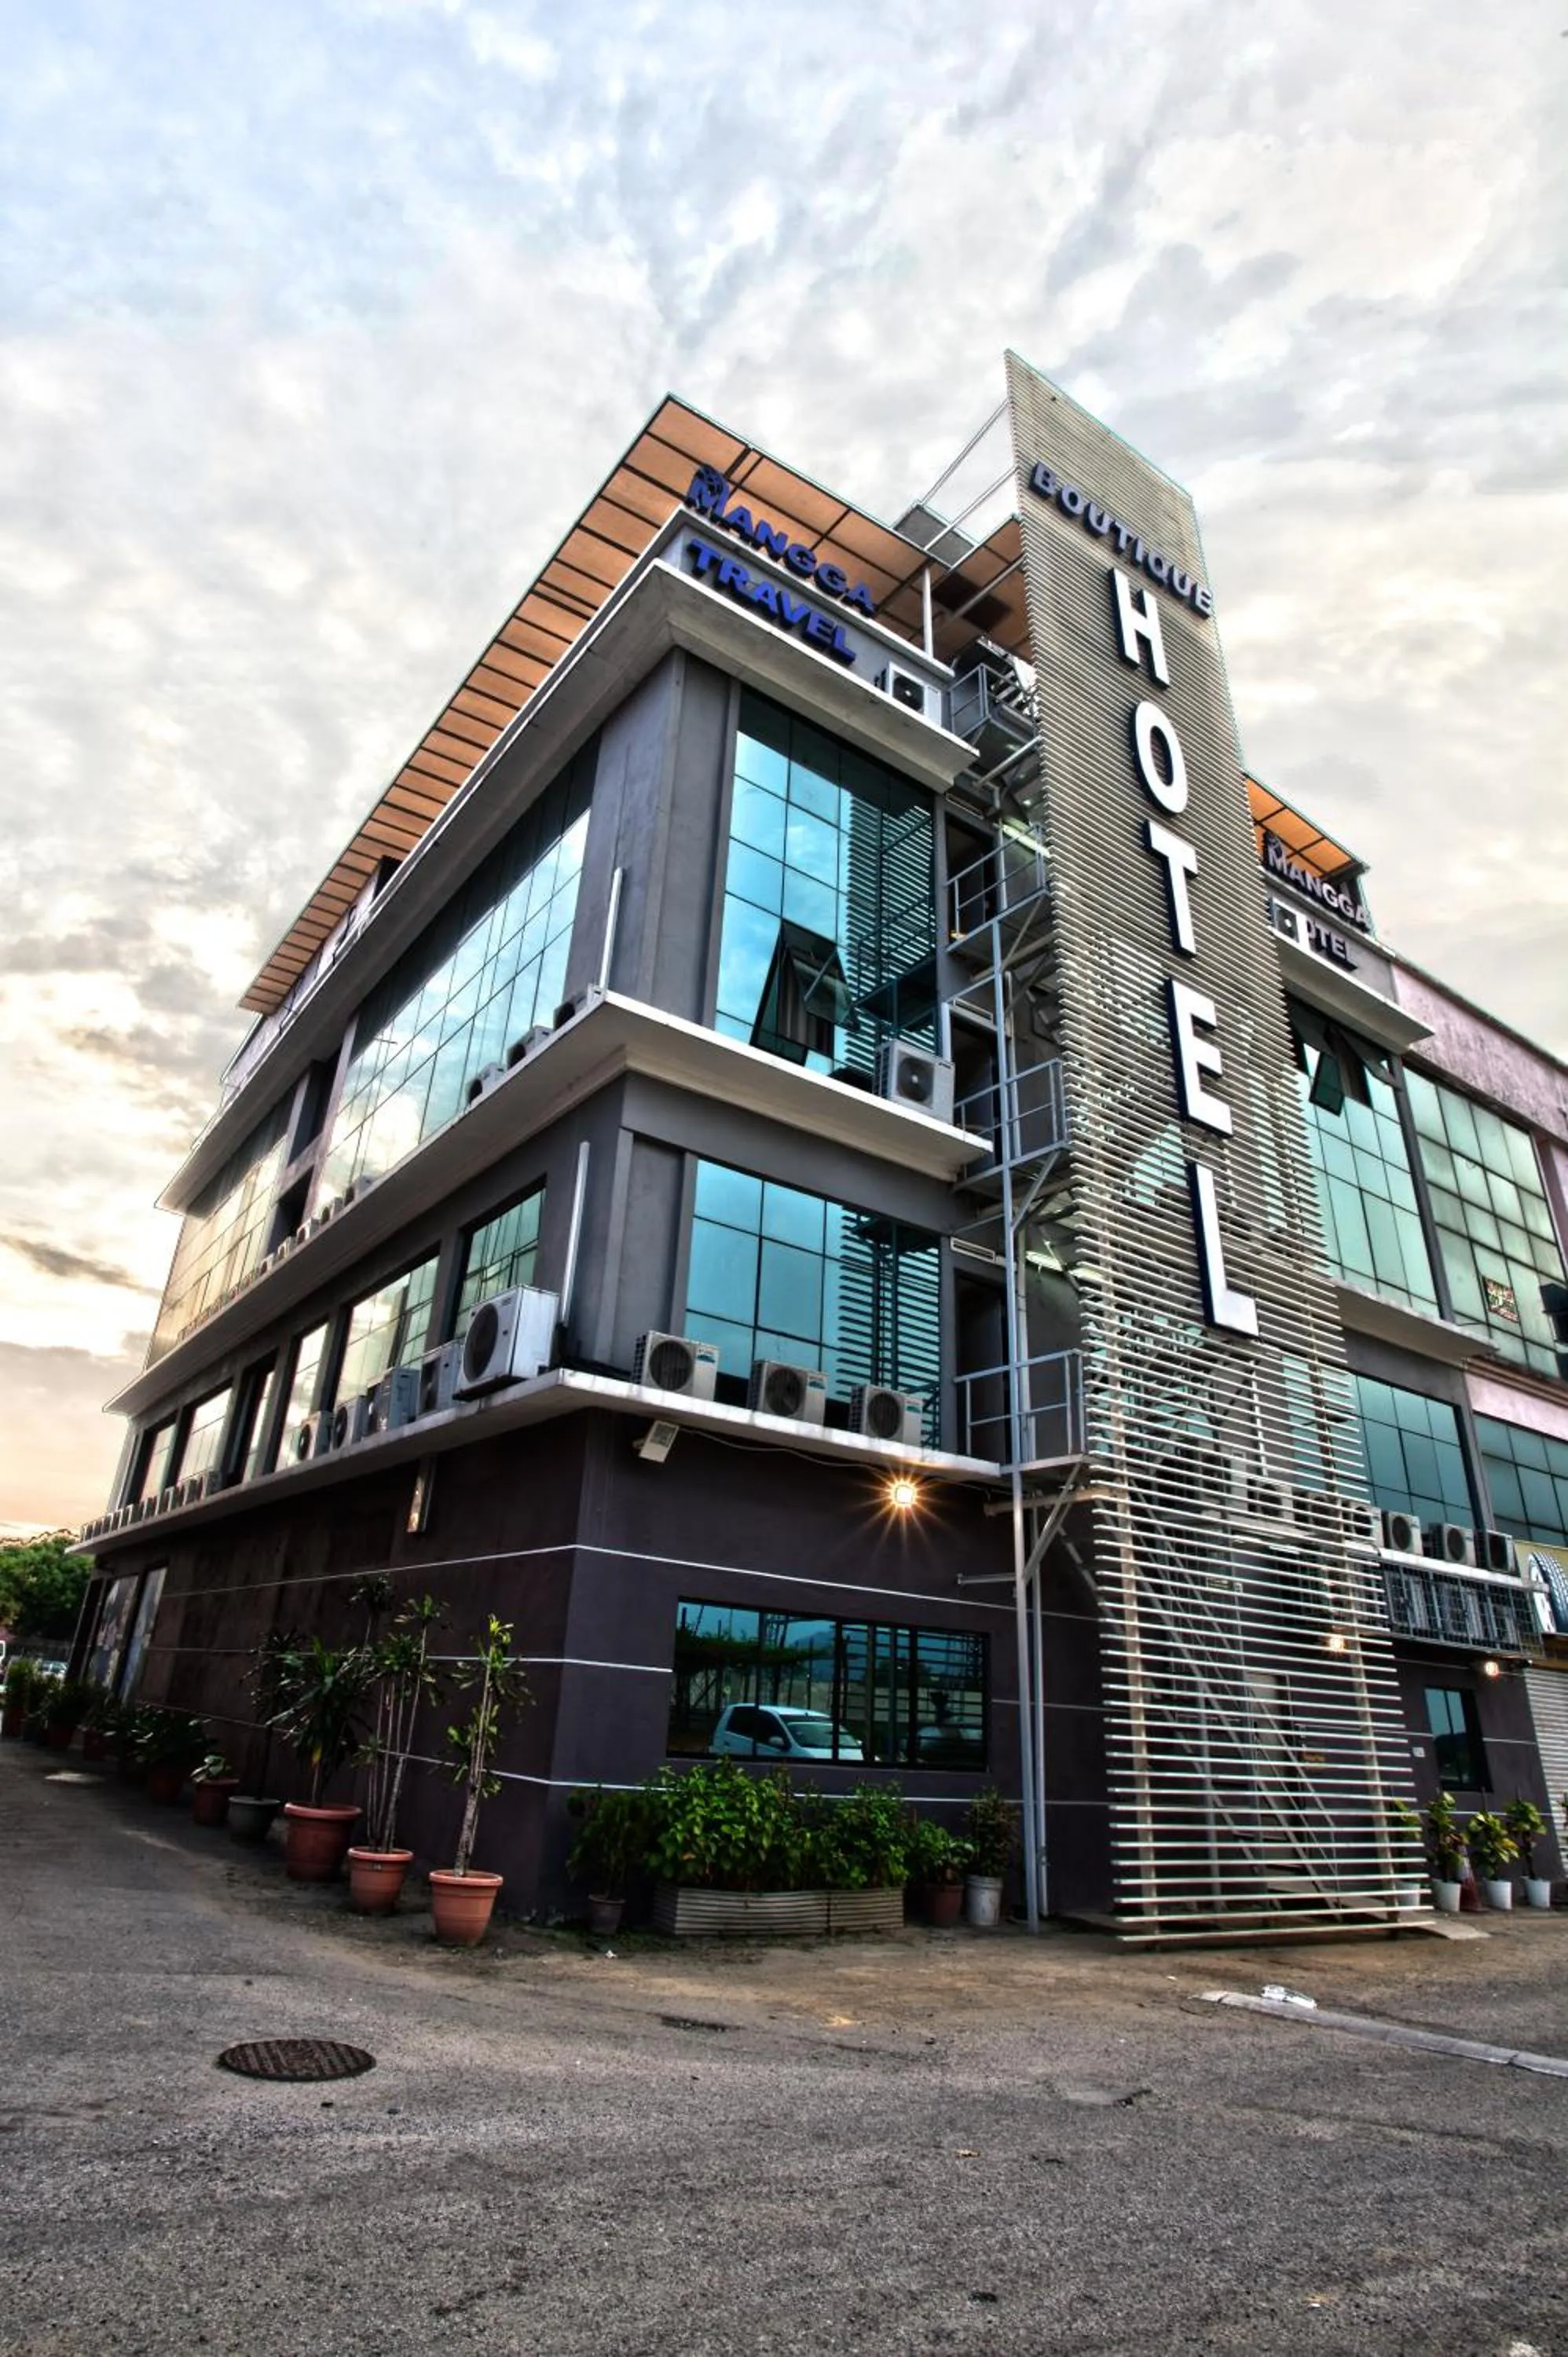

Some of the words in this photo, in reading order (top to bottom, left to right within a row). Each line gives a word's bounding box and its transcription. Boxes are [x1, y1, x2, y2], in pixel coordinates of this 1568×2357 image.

[685, 465, 876, 617] MANGGA
[688, 538, 856, 665] TRAVEL
[1030, 460, 1212, 619] BOUTIQUE
[1109, 567, 1258, 1337] HOTEL
[1262, 834, 1372, 933] MANGGA
[1305, 916, 1358, 971] OTEL
